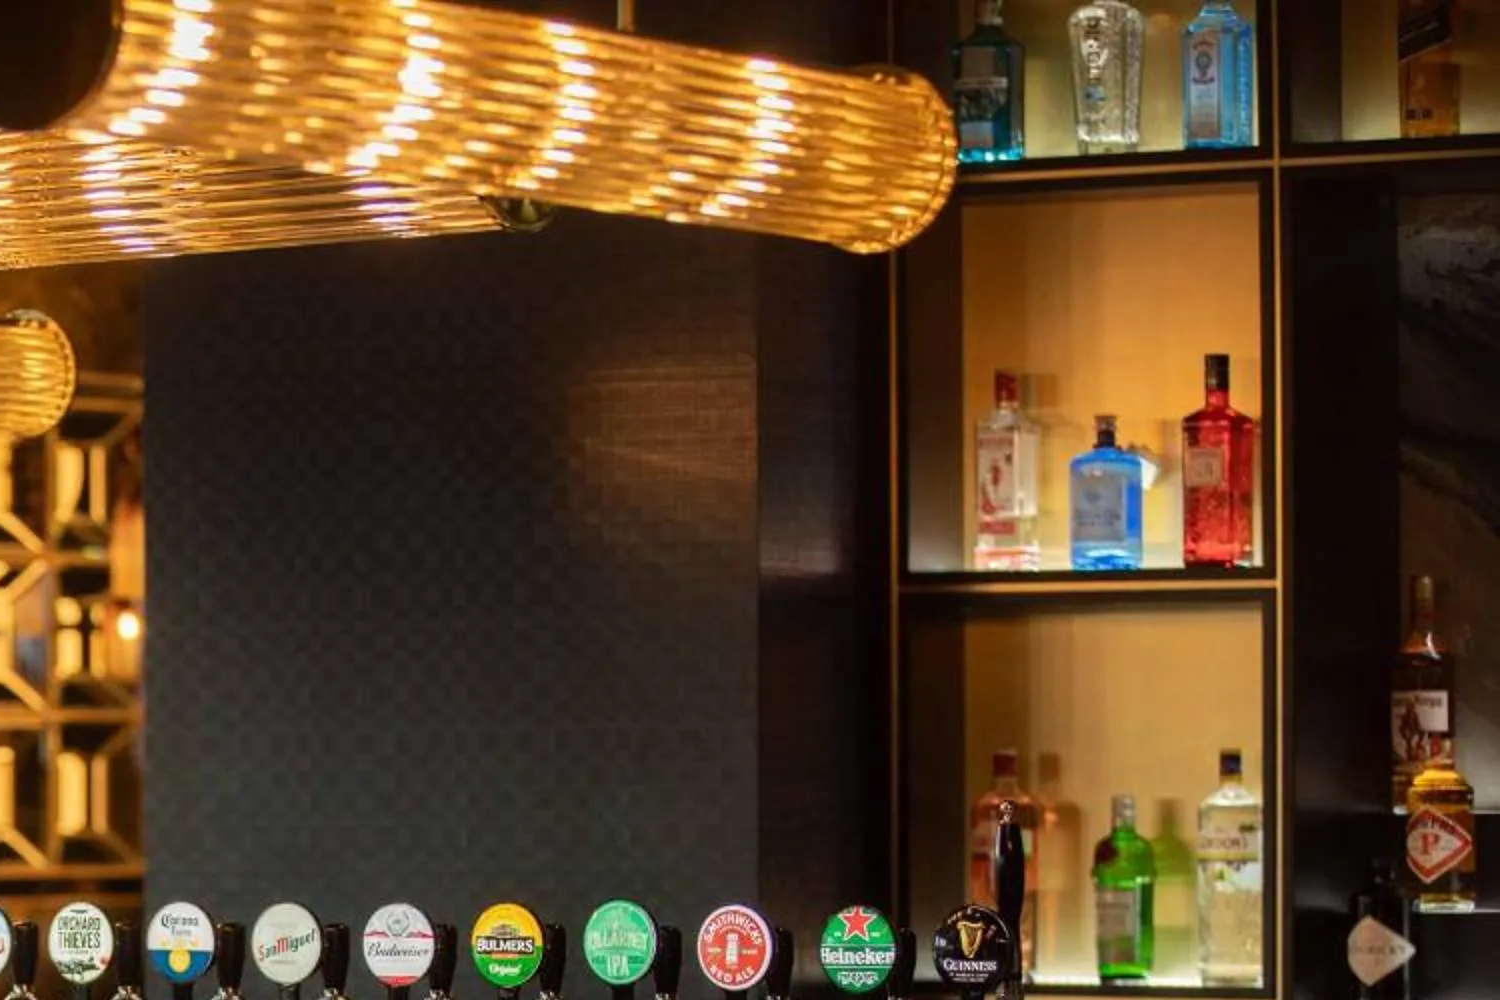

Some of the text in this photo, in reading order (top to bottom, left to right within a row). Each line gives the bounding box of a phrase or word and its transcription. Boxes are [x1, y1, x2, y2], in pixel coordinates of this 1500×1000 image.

[57, 915, 101, 931] ORCHARD
[161, 912, 199, 929] Corona
[57, 931, 101, 949] THIEVES
[477, 938, 534, 953] BULMERS
[366, 941, 430, 957] Budweiser
[821, 947, 896, 965] Heineken
[606, 954, 630, 976] IPA
[943, 957, 997, 971] GUINNESS
